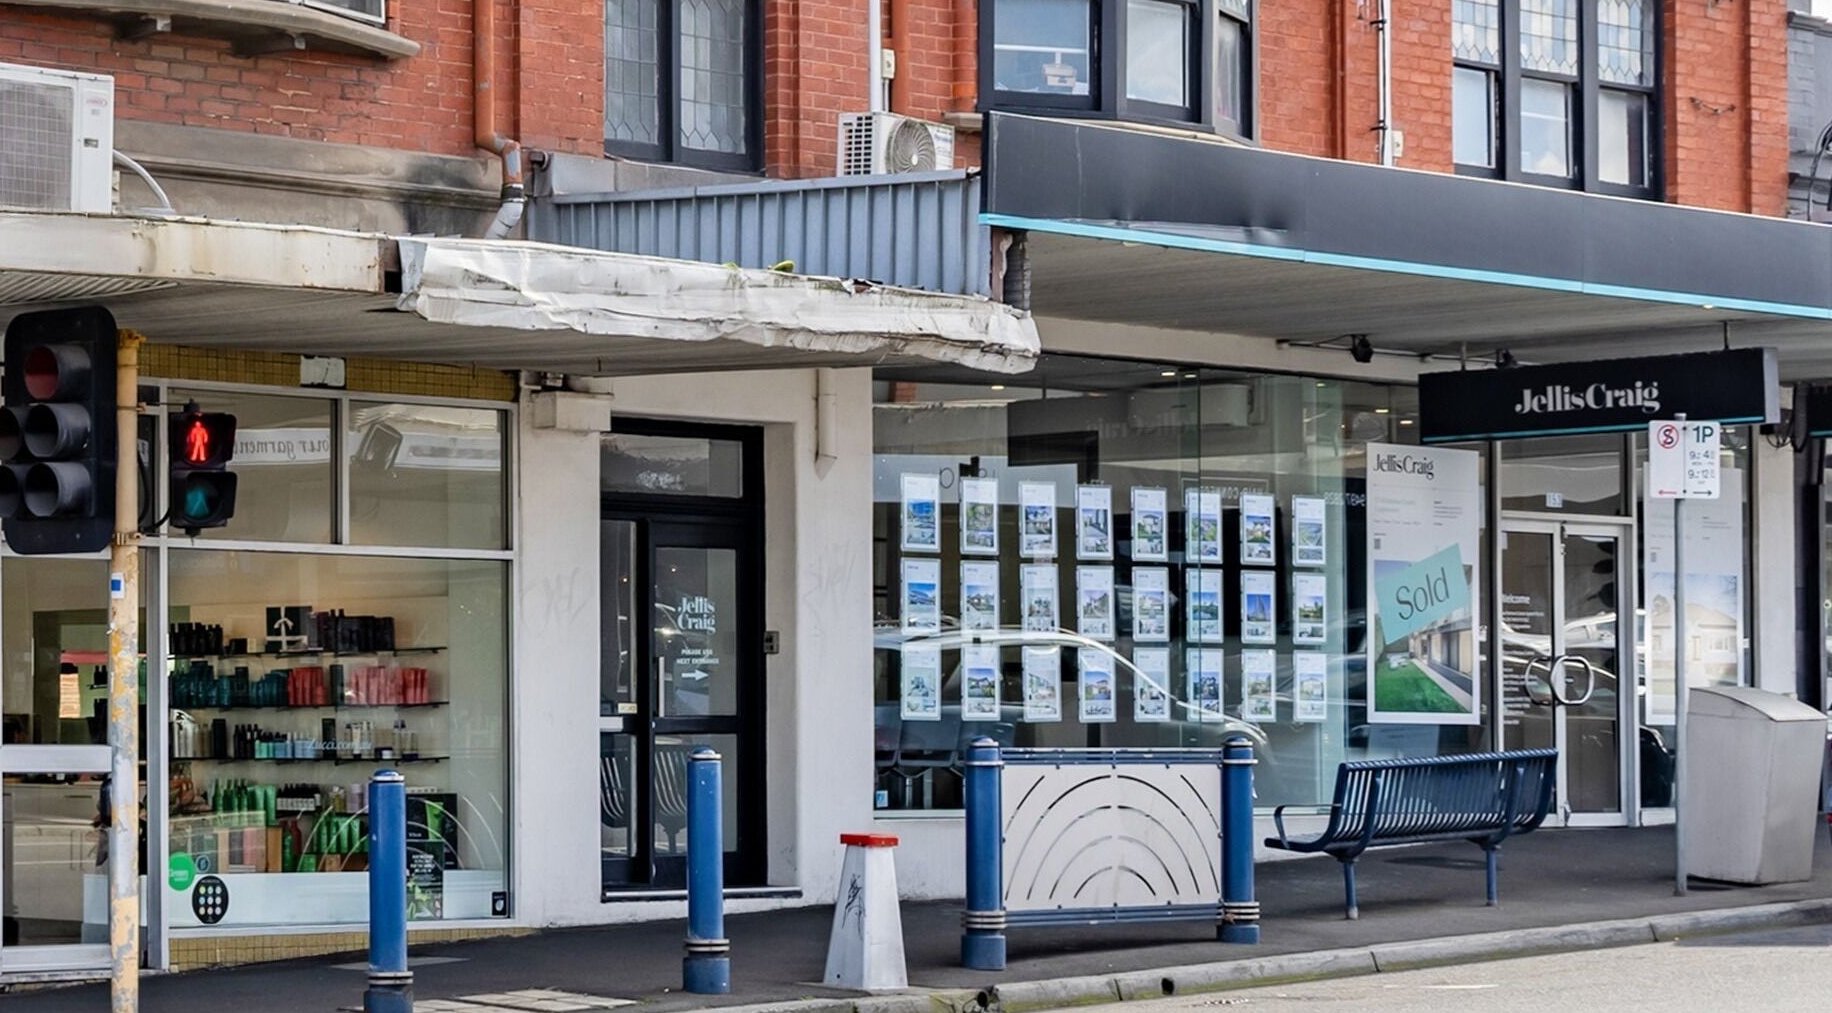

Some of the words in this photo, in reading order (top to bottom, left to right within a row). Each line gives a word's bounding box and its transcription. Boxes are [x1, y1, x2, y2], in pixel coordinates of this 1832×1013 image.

[1692, 425, 1714, 443] 1P
[1396, 566, 1449, 621] Sold
[677, 596, 715, 614] Jellis
[677, 613, 716, 634] Craig
